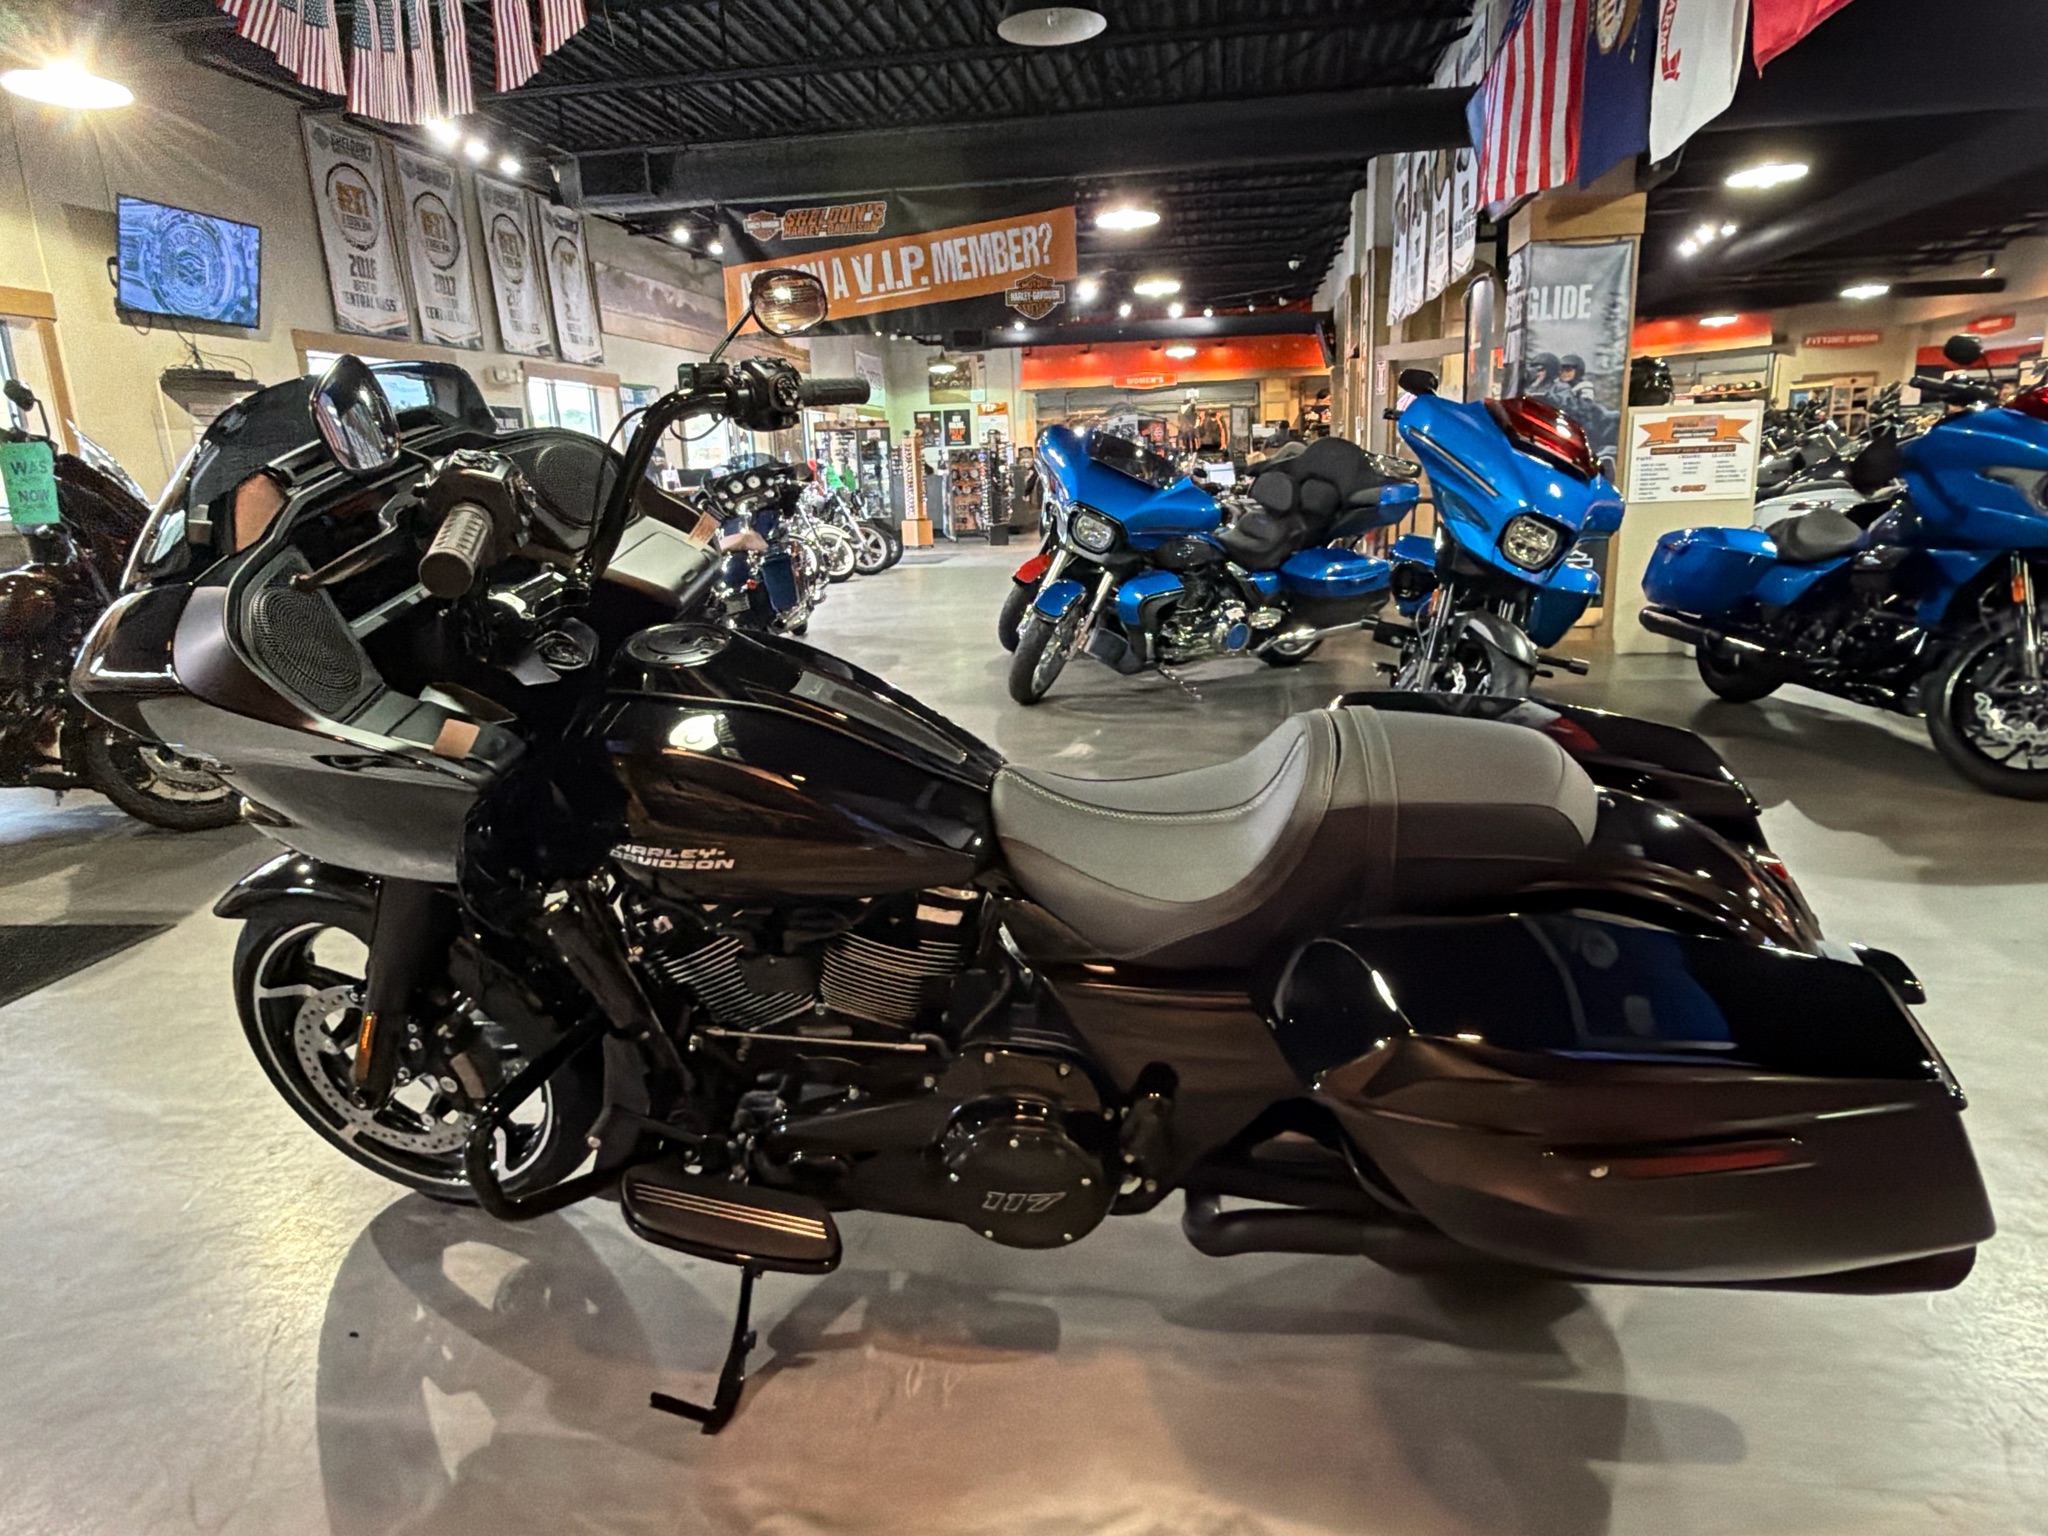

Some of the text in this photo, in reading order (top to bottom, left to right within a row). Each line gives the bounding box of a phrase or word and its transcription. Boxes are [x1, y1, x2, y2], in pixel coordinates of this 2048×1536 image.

[785, 203, 883, 227] SHELDON'S
[832, 257, 850, 299] A
[851, 244, 929, 295] V.I.P.
[930, 222, 1053, 285] MEMBER?
[1527, 284, 1594, 321] GLIDE
[1126, 376, 1164, 385] WOMEN'S
[10, 461, 48, 475] WAS
[18, 489, 49, 502] NOW
[609, 849, 735, 870] DAVIDSON
[616, 843, 726, 859] HARLEY-
[982, 1190, 1067, 1212] 117
